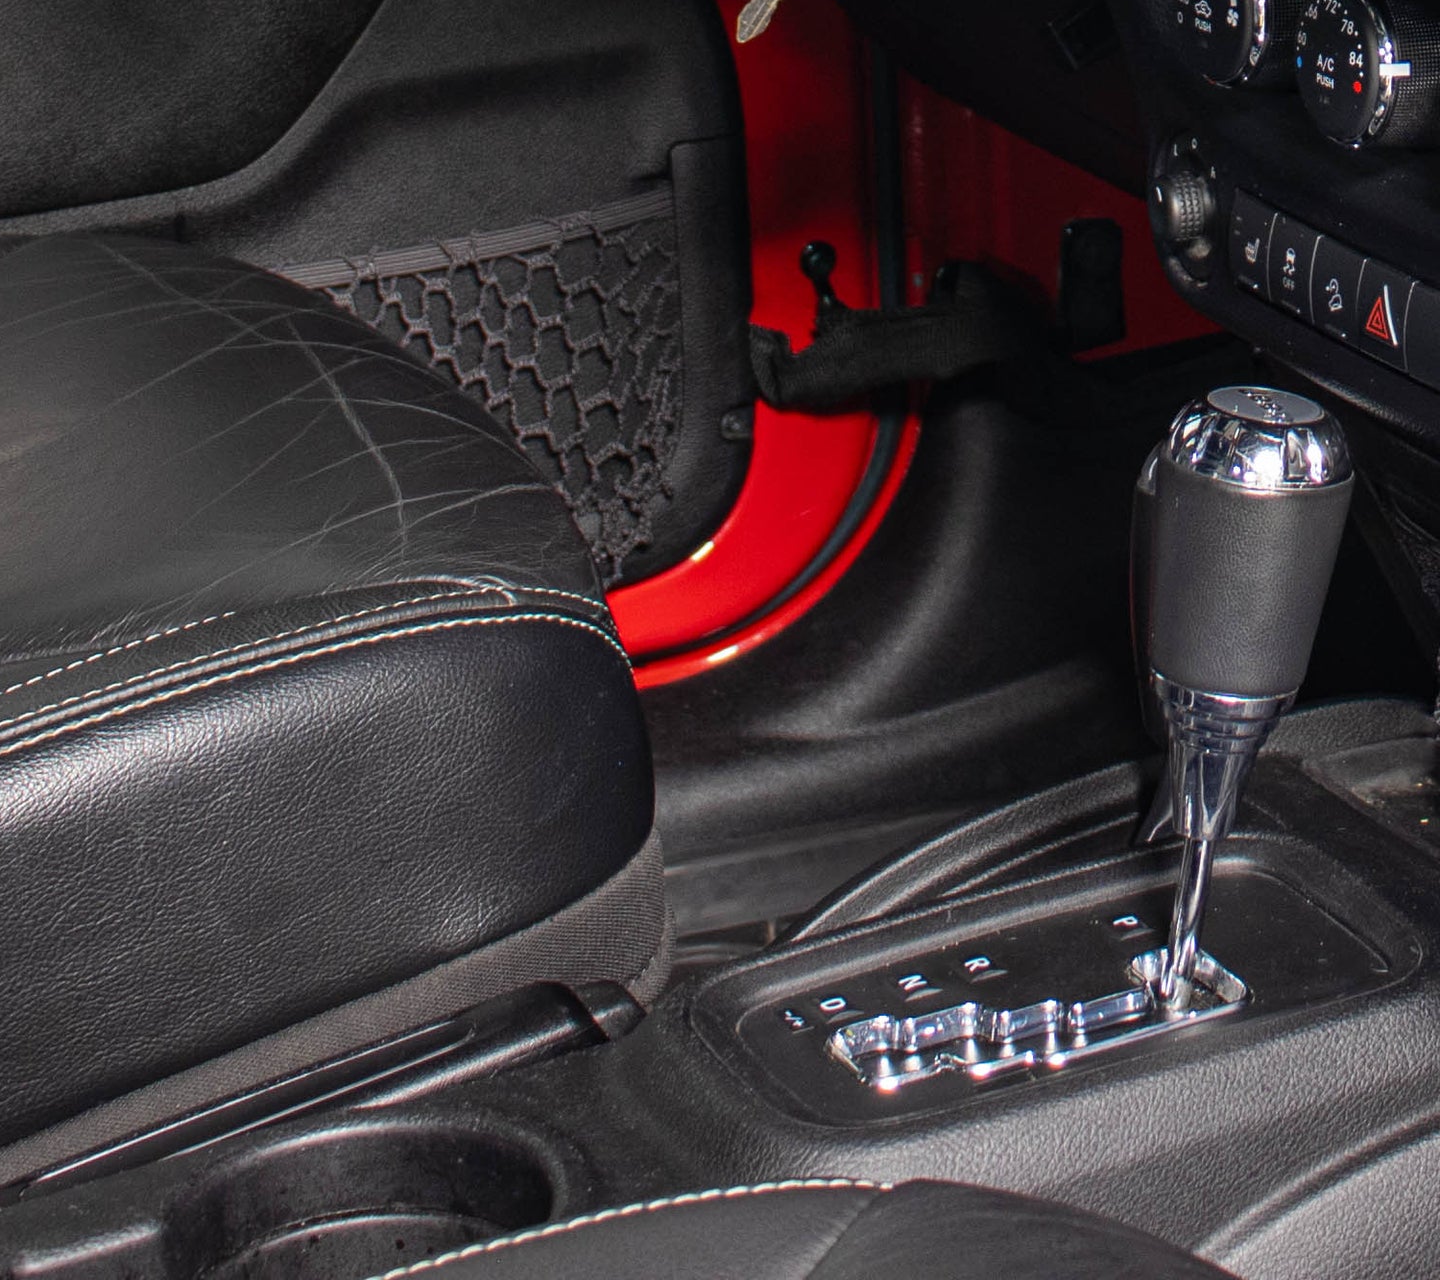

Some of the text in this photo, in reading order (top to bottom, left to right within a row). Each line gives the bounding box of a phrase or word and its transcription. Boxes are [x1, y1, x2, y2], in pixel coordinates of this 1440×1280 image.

[1194, 17, 1213, 34] PUSH
[1341, 18, 1354, 36] 78
[1316, 52, 1335, 72] A/C
[1348, 50, 1364, 69] 84
[1316, 72, 1335, 90] PUSH
[1112, 914, 1140, 929] P
[963, 955, 992, 974] R
[897, 973, 929, 993] N
[819, 995, 847, 1014] D
